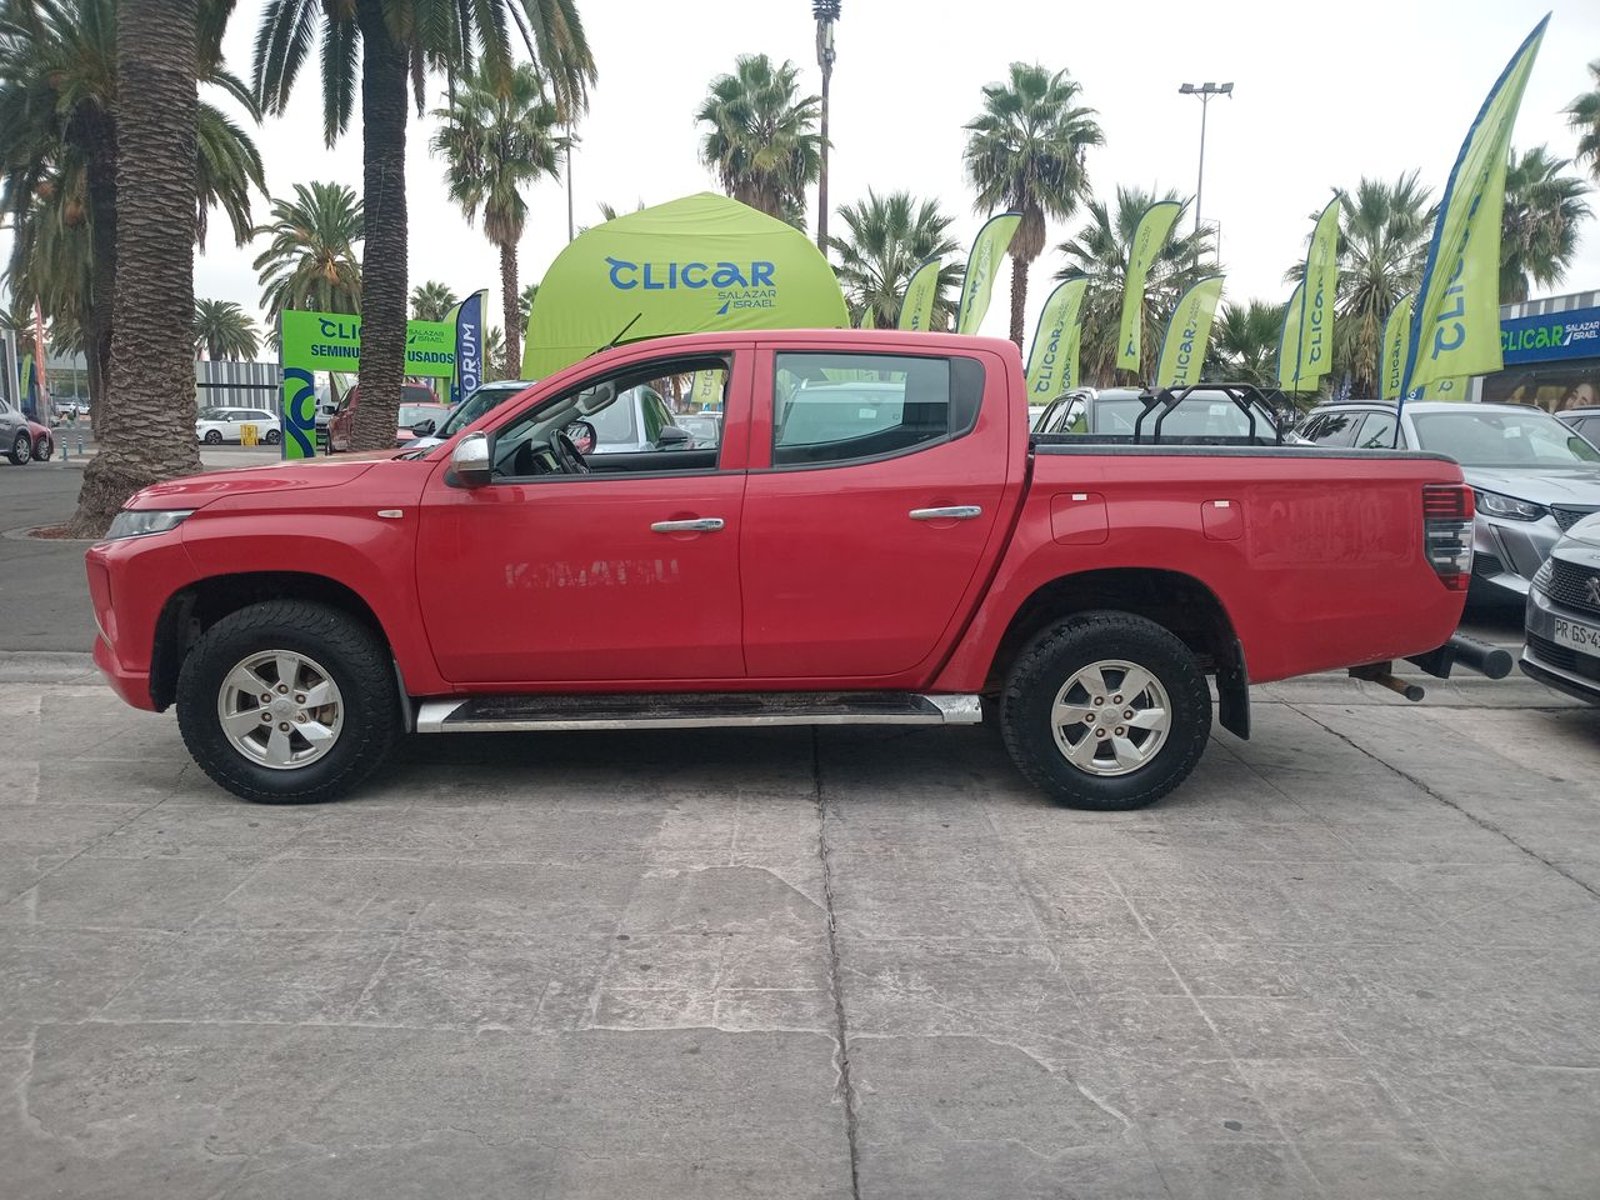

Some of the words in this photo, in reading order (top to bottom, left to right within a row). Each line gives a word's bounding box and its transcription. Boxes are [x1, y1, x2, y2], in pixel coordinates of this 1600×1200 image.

[718, 289, 777, 301] SALAZAR
[733, 299, 776, 309] ISRAEL
[1565, 321, 1600, 332] SALAZAR
[1572, 331, 1598, 341] ISRAEL
[311, 344, 361, 358] SEMINU
[407, 350, 455, 365] USADOS
